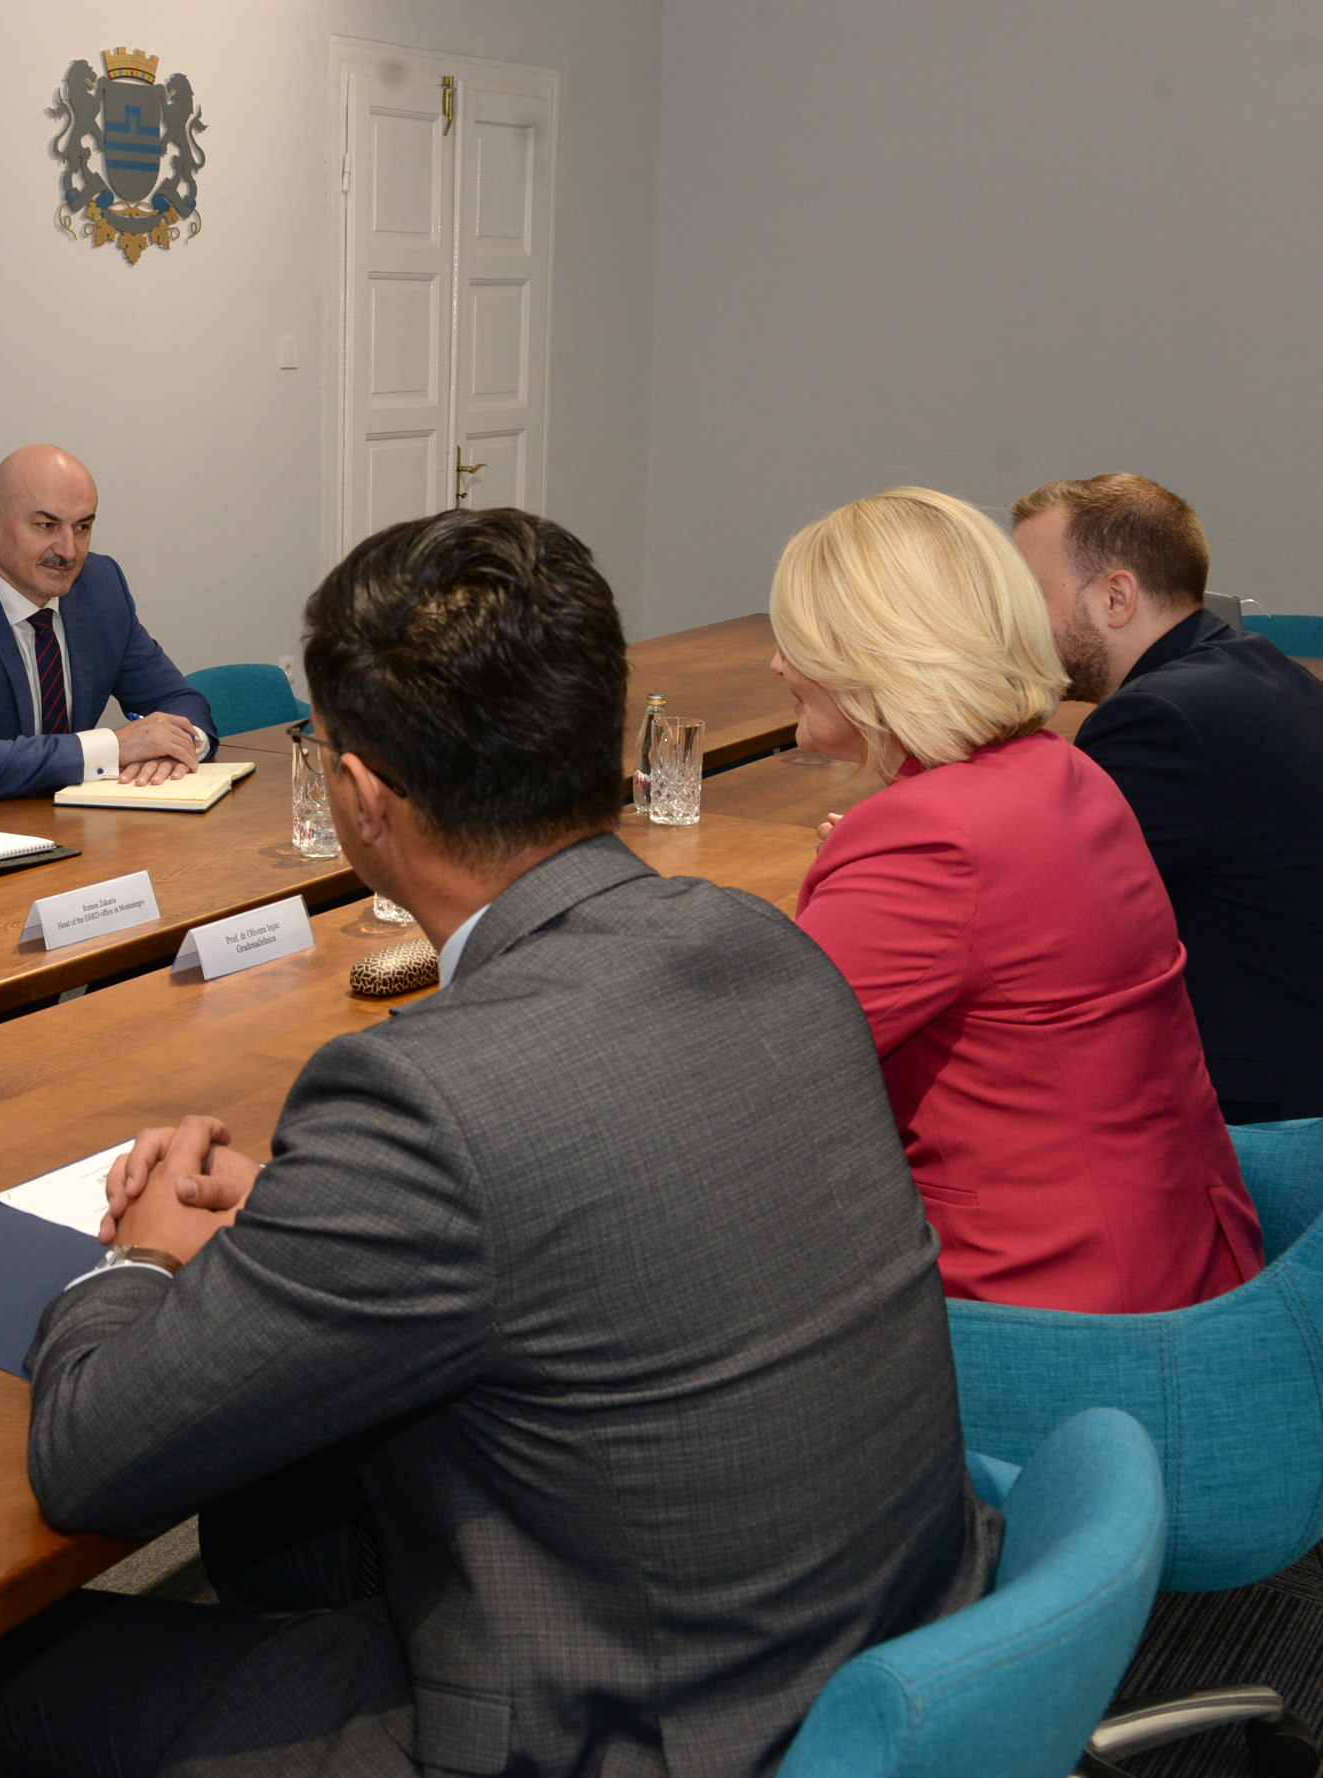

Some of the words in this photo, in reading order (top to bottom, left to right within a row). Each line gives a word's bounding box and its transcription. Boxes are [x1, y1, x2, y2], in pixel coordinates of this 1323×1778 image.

[99, 897, 117, 908] Zakaria
[57, 920, 70, 929] Head
[84, 911, 100, 922] EBRD
[100, 908, 114, 917] office
[118, 900, 145, 911] Montenegro
